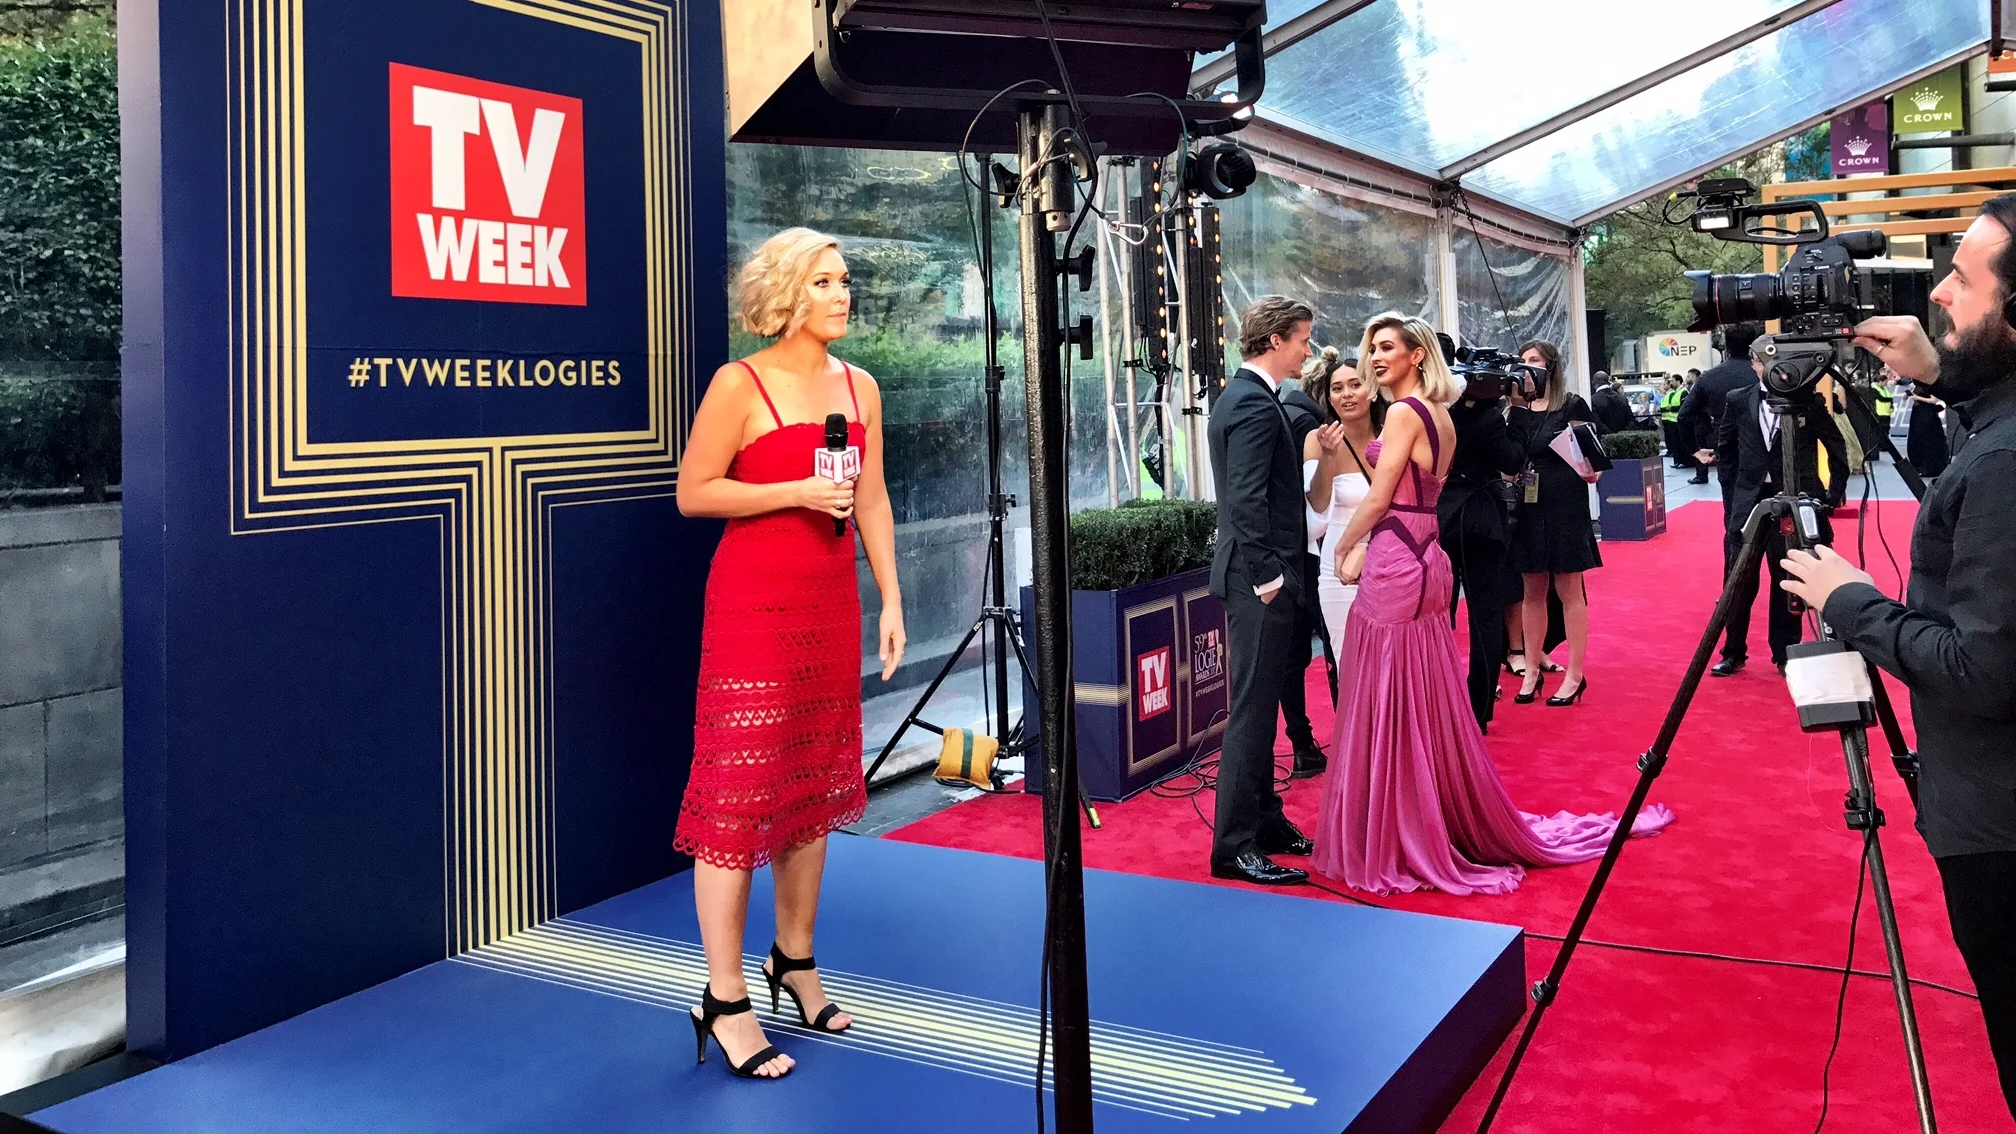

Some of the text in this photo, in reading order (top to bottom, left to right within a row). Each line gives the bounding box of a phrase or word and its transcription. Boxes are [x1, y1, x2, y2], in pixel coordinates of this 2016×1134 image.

[1903, 112, 1952, 124] CROWN
[412, 85, 566, 219] TV
[1838, 156, 1880, 167] CROWN
[416, 213, 571, 288] WEEK
[1670, 345, 1697, 357] NEP
[348, 358, 622, 388] #TVWEEKLOGIES
[819, 453, 834, 471] TV
[842, 449, 856, 469] TV
[1141, 651, 1167, 694] TV
[1194, 648, 1216, 673] LOGIE
[1142, 686, 1168, 715] WEEK
